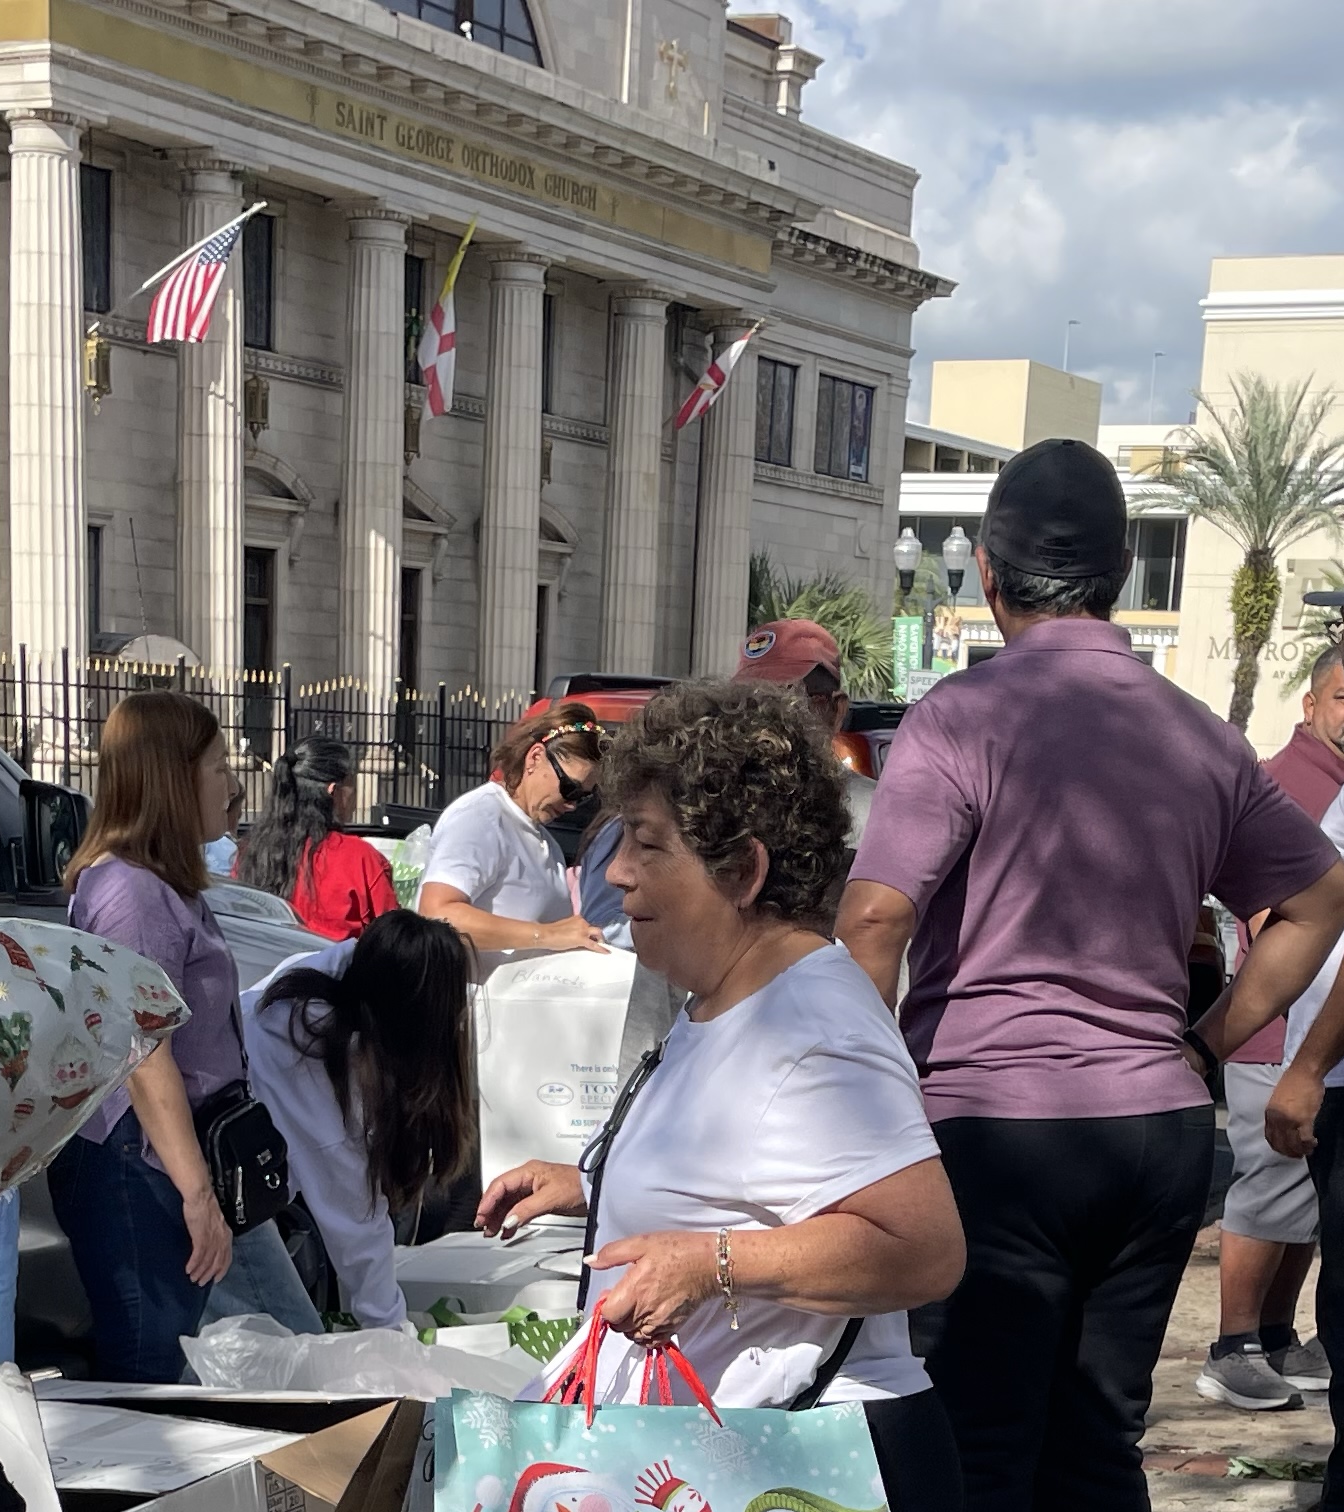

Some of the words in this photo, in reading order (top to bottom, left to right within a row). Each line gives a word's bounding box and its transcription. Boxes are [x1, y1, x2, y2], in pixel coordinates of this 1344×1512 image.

[335, 101, 387, 140] SAINT
[395, 121, 454, 163] GEORGE
[461, 144, 536, 190] ORTHODOX
[544, 173, 597, 211] CHURCH
[570, 1063, 593, 1073] There
[594, 1064, 601, 1073] is
